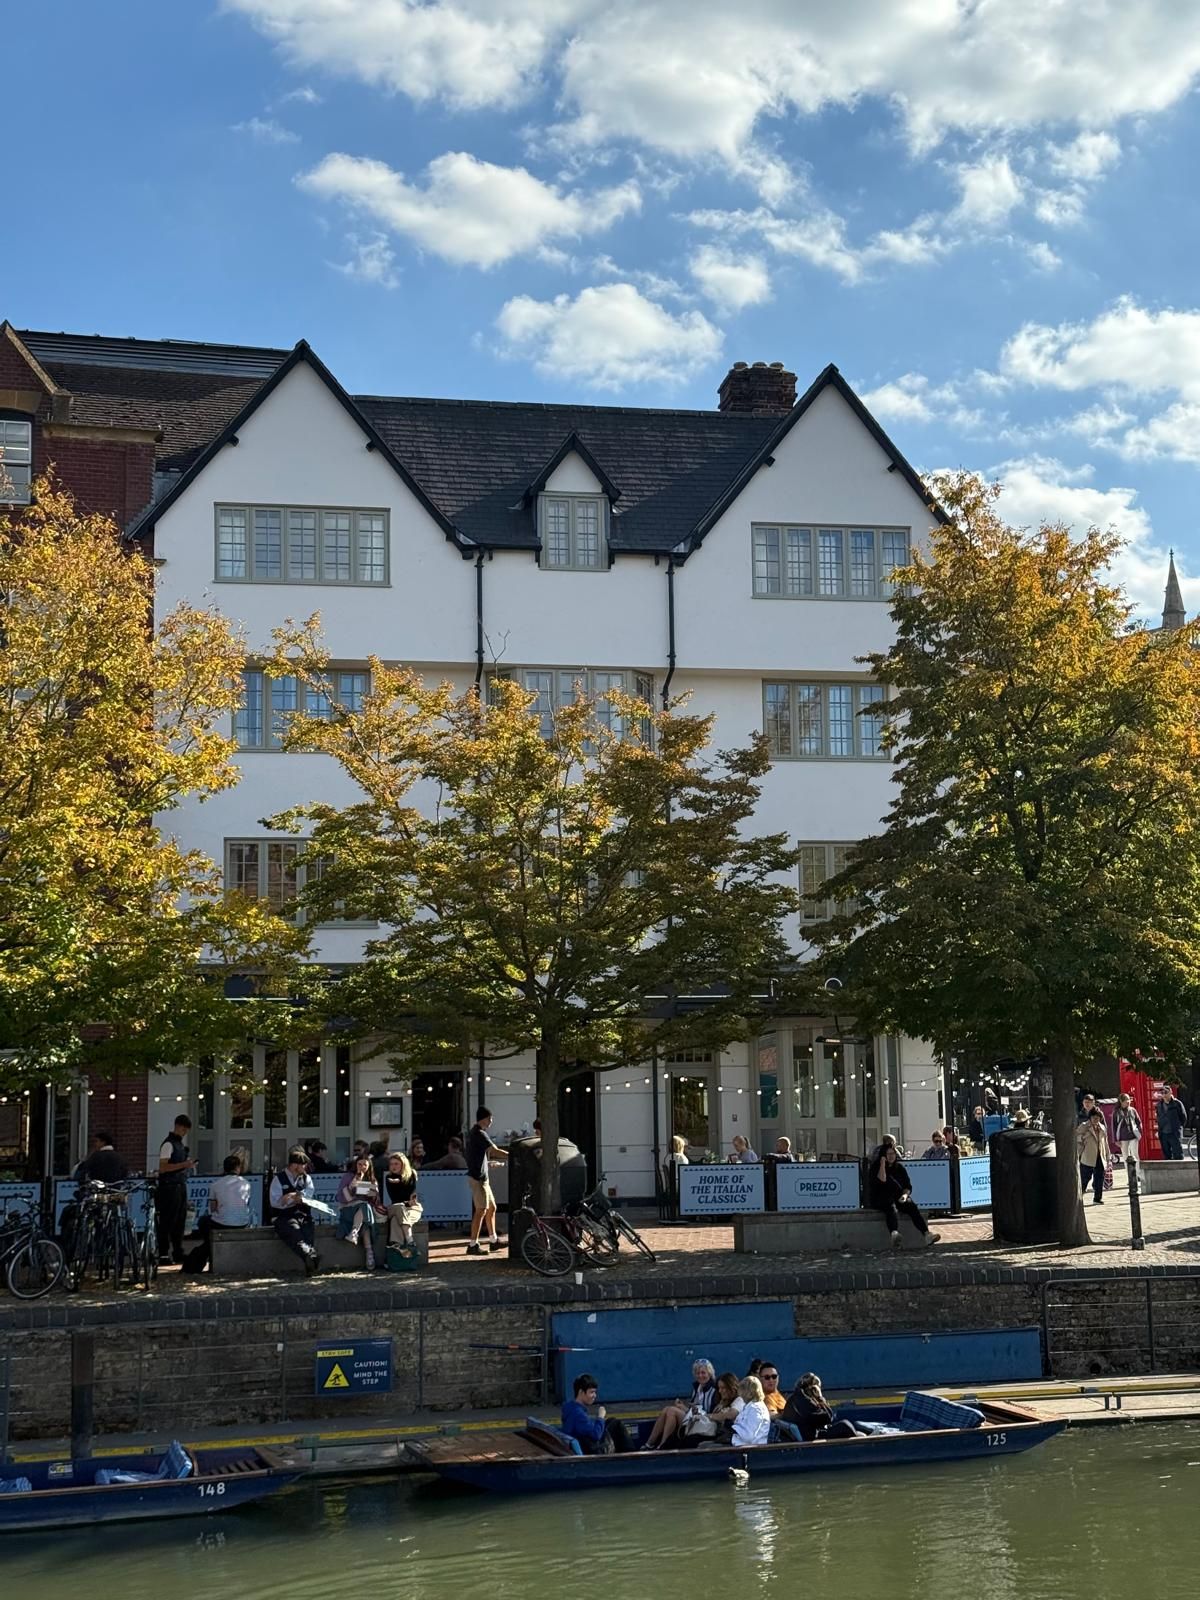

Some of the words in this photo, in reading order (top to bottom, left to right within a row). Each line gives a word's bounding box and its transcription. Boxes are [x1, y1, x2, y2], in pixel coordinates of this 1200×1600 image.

[699, 1175, 729, 1184] HOME
[731, 1174, 745, 1183] OF
[690, 1185, 711, 1194] THE
[713, 1184, 753, 1194] ITALIAN
[800, 1181, 837, 1191] PREZZO
[698, 1194, 747, 1204] CLASSICS
[354, 1360, 388, 1368] CAUTION!
[987, 1432, 1007, 1446] 125
[198, 1482, 226, 1497] 148
